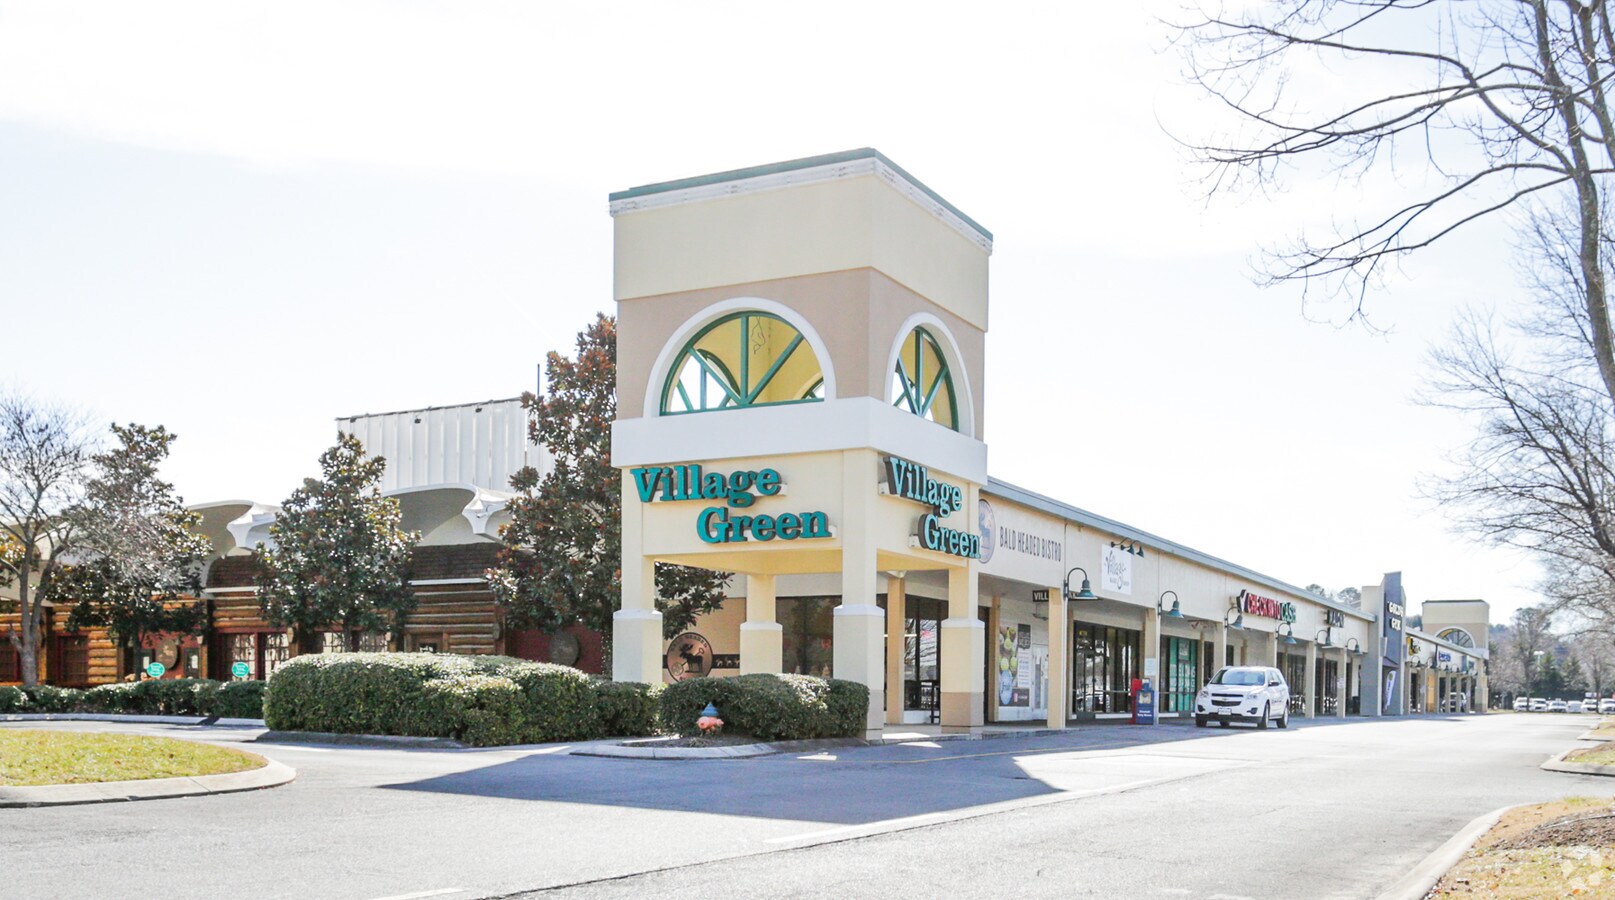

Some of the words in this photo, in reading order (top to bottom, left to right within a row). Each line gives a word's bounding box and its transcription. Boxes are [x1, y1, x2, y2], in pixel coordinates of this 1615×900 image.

[630, 464, 783, 508] Village
[885, 456, 963, 518] Village
[697, 506, 833, 543] Green
[920, 513, 982, 560] Green
[1000, 526, 1016, 551] BALD
[1018, 531, 1040, 557] HEADED
[1042, 538, 1061, 563] BISTRO
[1033, 591, 1049, 601] VILL
